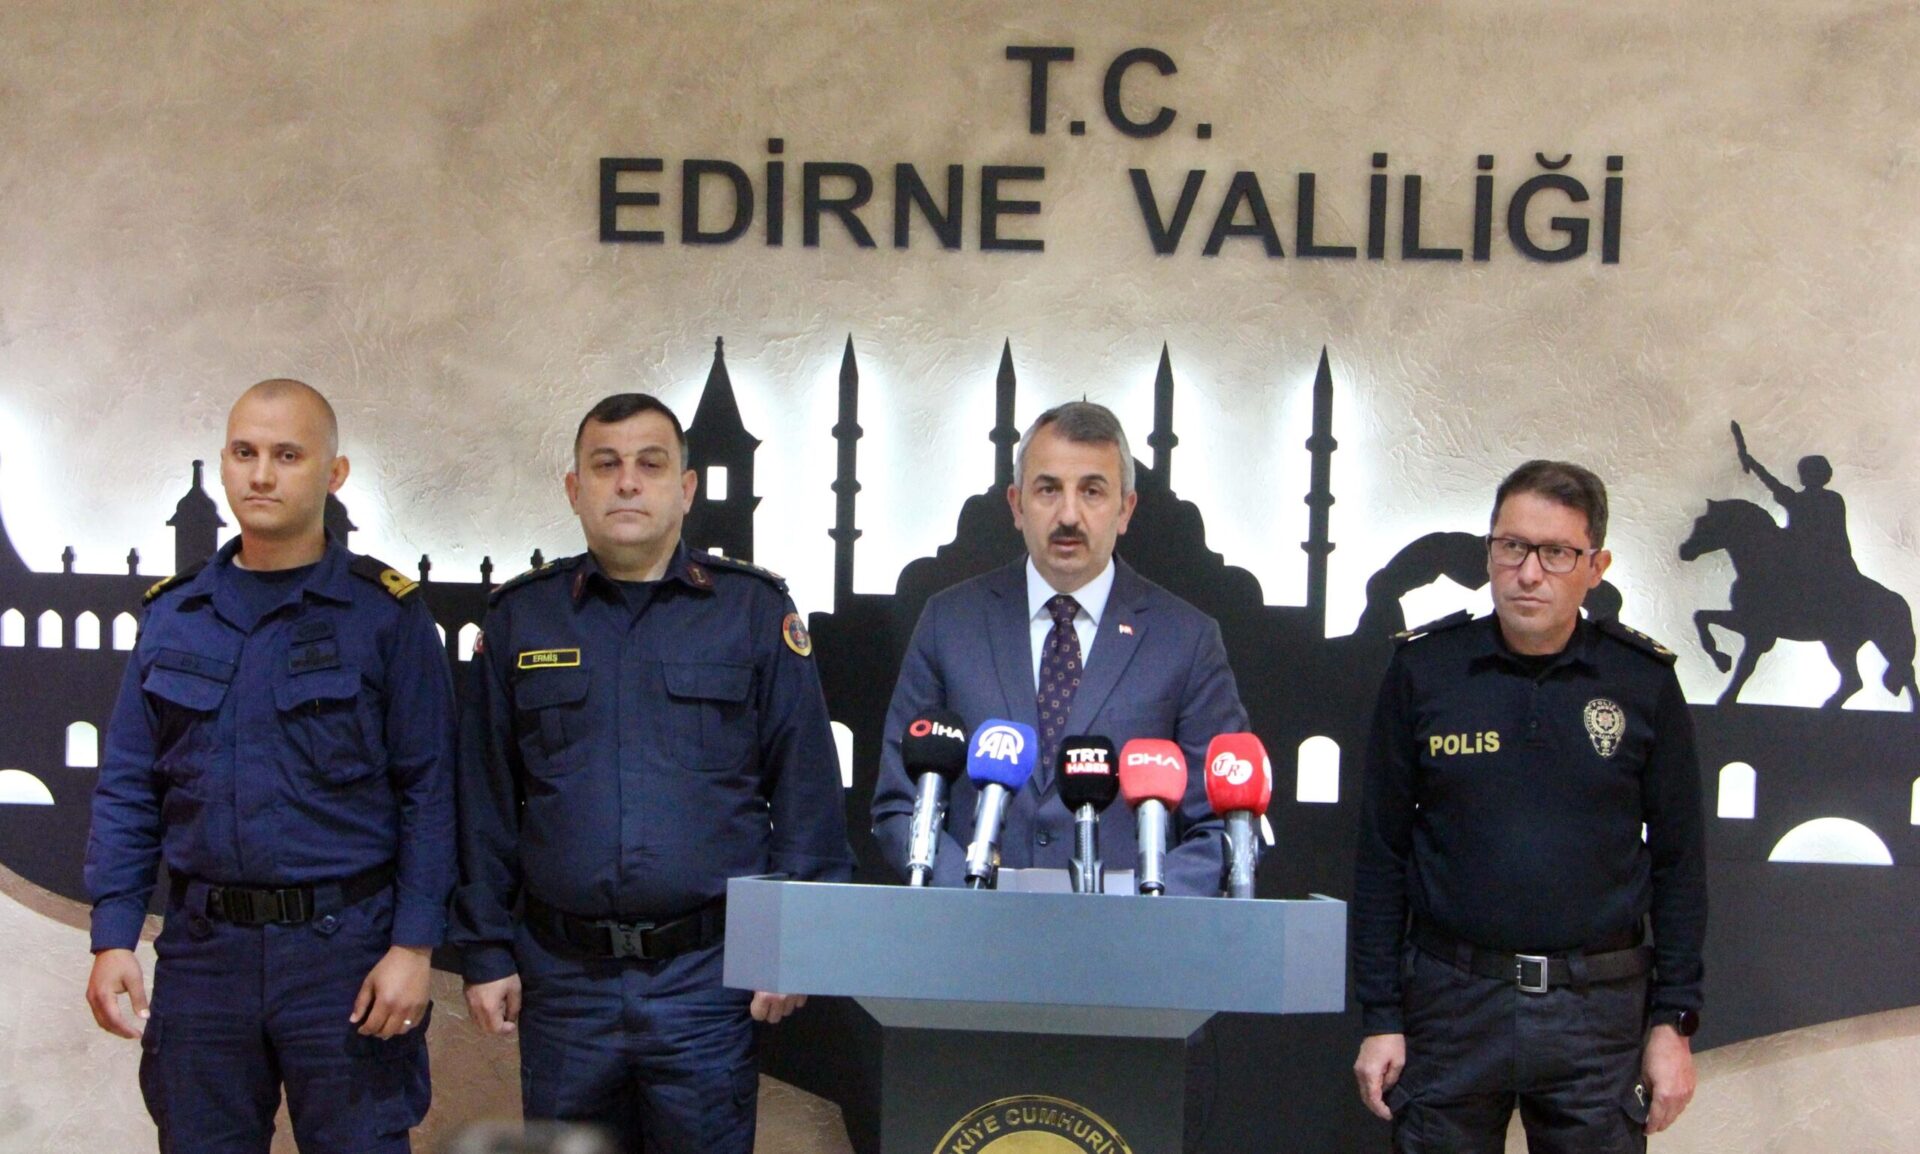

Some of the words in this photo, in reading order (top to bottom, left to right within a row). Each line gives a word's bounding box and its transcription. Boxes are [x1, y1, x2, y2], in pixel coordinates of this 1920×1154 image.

[599, 137, 1045, 252] EDİRNE
[1128, 152, 1624, 265] VALİLİĞİ
[1066, 748, 1108, 763] TRT
[1127, 752, 1180, 770] DHA
[1066, 762, 1110, 775] HABER
